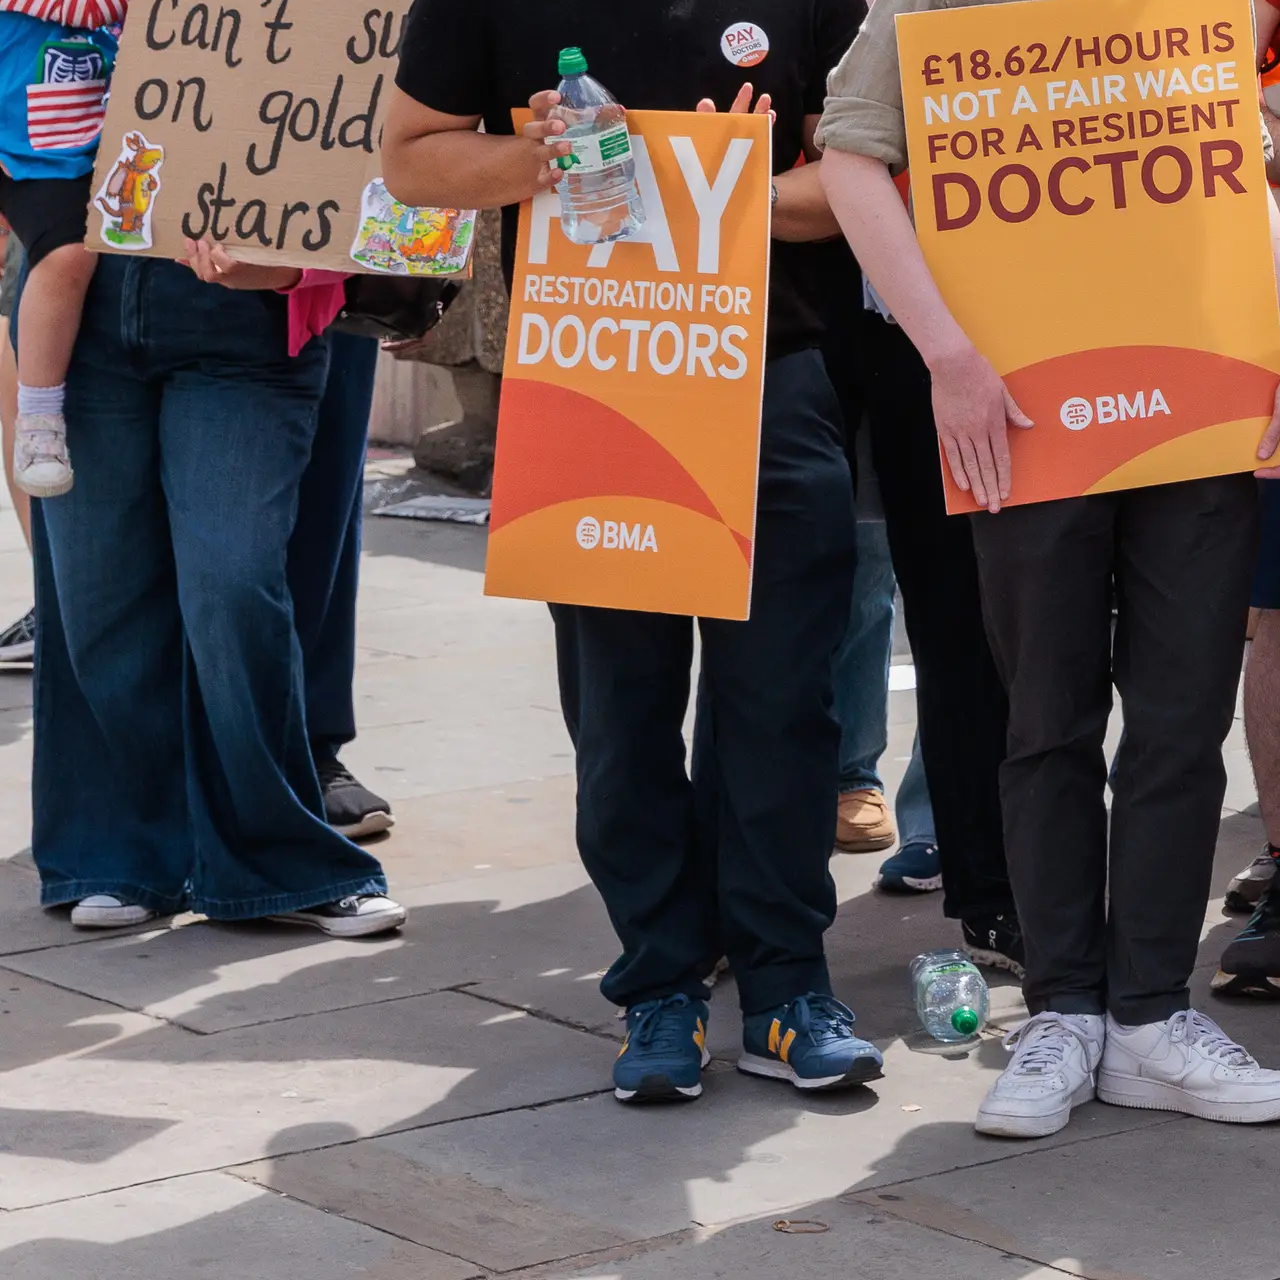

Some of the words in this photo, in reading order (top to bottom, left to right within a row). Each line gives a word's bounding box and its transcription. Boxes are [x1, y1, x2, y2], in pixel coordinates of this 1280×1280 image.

[725, 26, 753, 46] PAY
[732, 42, 761, 56] DOCTORS
[921, 24, 1189, 86] £18.62/HOUR
[1201, 22, 1235, 53] IS
[135, 74, 212, 133] on
[923, 88, 1001, 124] NOT
[1010, 84, 1038, 115] A
[1046, 72, 1126, 111] FAIR
[1134, 61, 1239, 100] WAGE
[927, 127, 1007, 163] FOR
[1015, 123, 1044, 153] A
[1052, 100, 1240, 148] RESIDENT
[181, 162, 340, 252] stars
[931, 139, 1248, 232] DOCTOR
[523, 275, 694, 312] RESTORATION
[701, 286, 751, 314] FOR
[517, 313, 749, 379] DOCTORS
[1097, 389, 1171, 425] BMA
[603, 521, 657, 552] BMA
